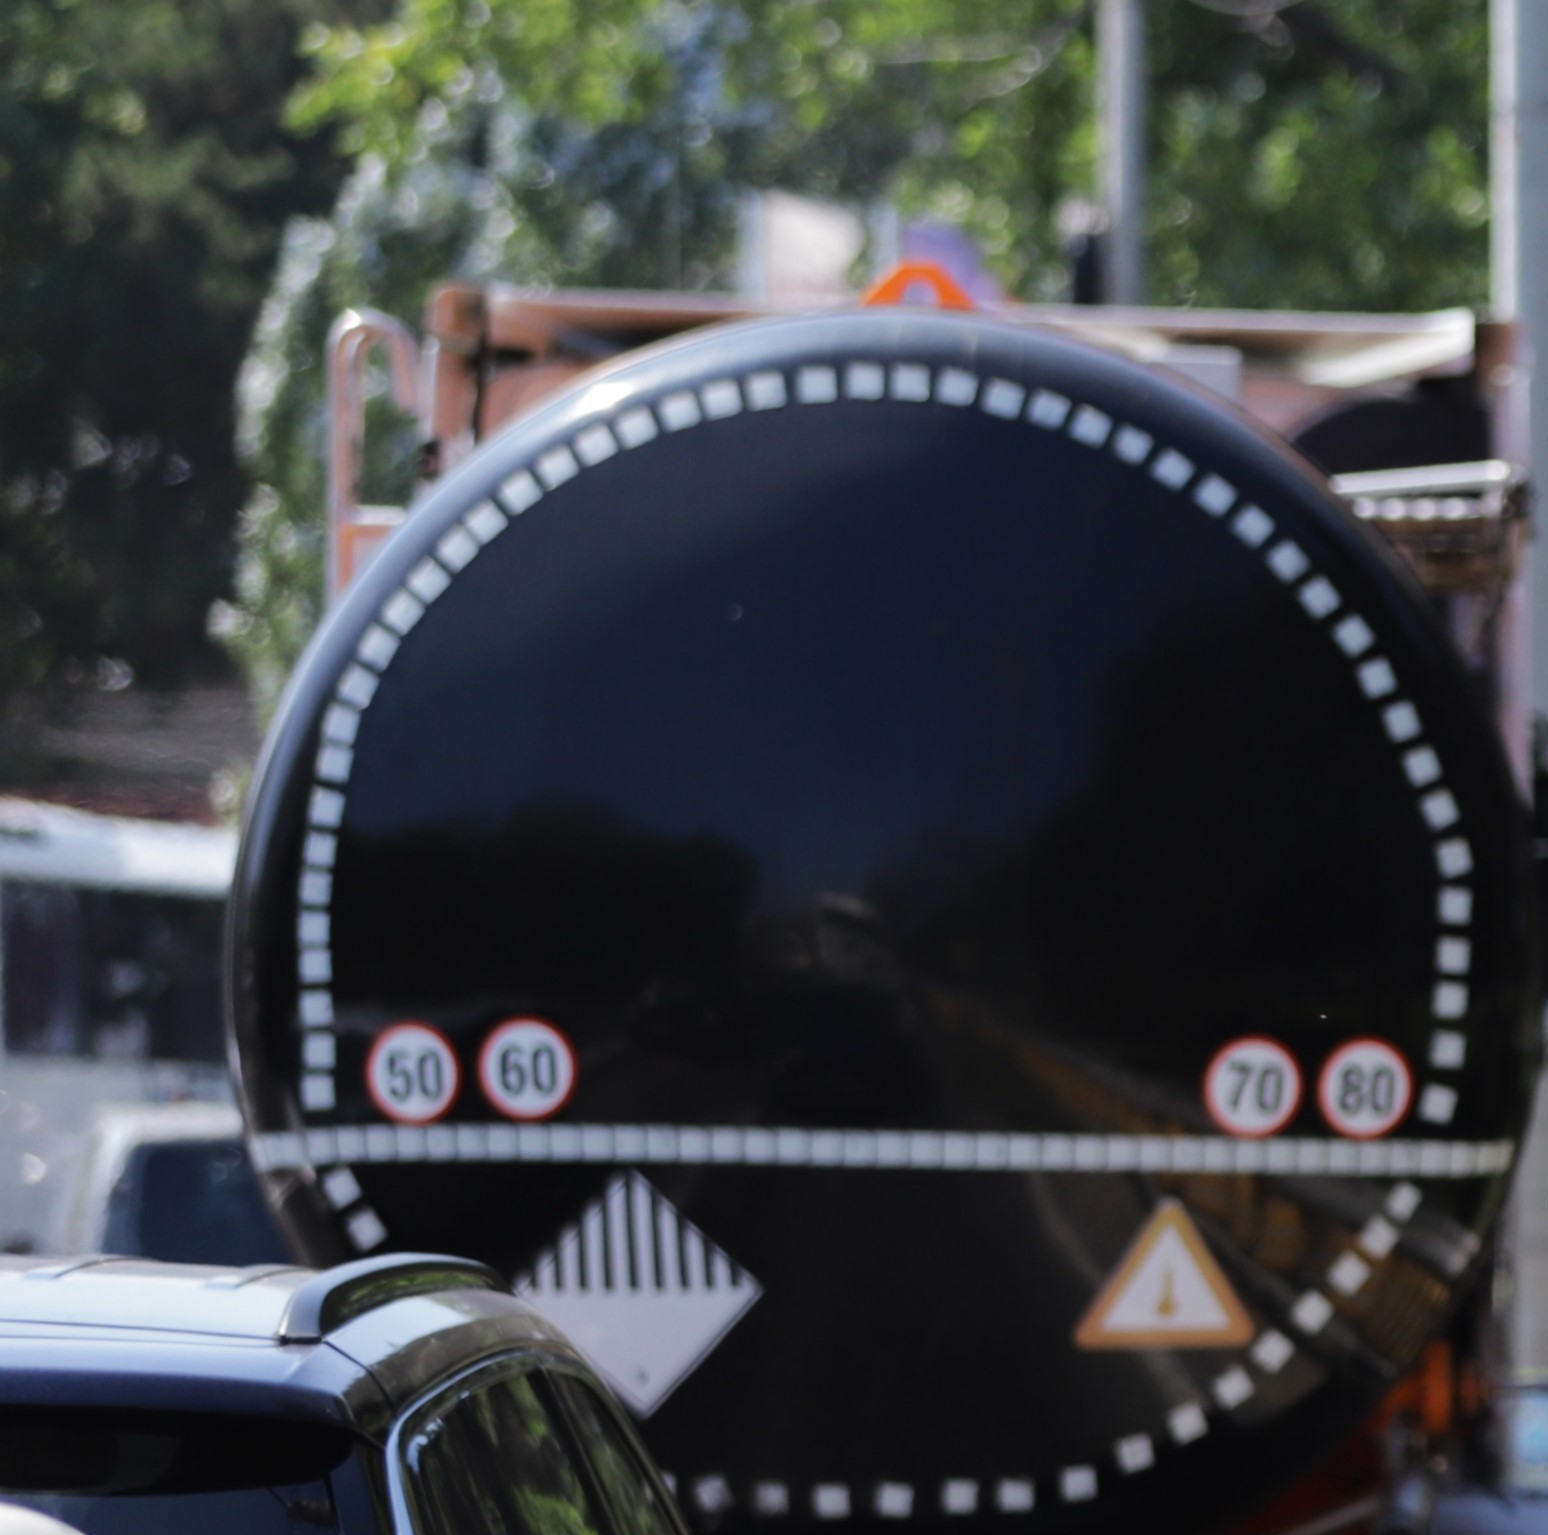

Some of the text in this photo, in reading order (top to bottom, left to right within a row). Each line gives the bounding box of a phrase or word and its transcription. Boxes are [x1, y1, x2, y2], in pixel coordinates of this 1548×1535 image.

[386, 1050, 444, 1102] 50
[499, 1045, 557, 1096] 60
[1229, 1060, 1285, 1116] 70
[1338, 1065, 1396, 1117] 80
